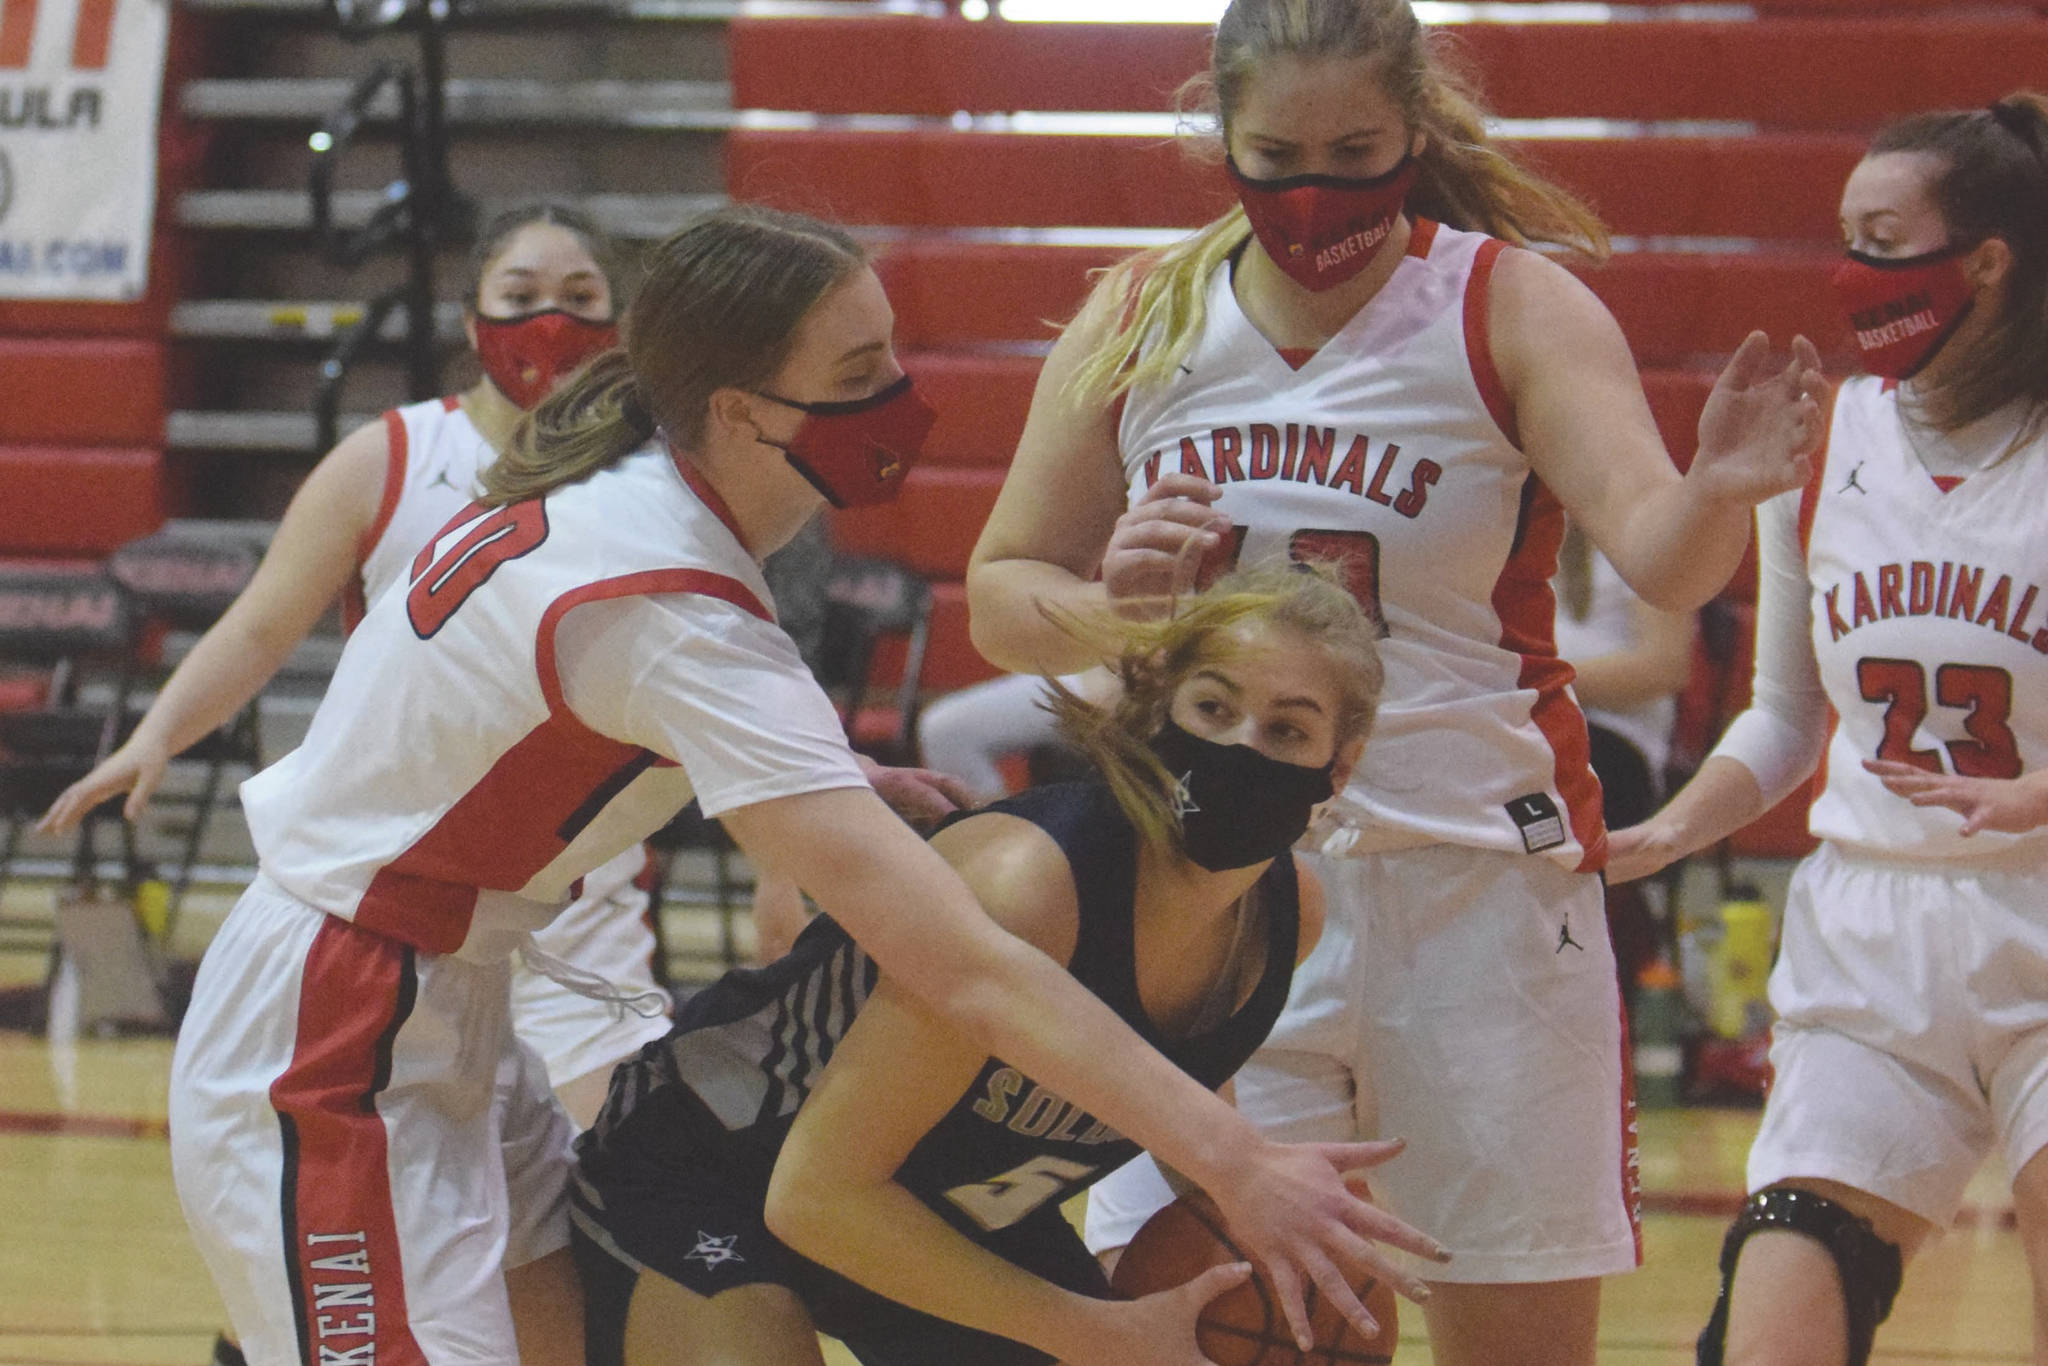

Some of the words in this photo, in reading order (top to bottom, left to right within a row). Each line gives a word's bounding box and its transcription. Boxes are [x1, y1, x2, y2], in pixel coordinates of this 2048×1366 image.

[1314, 216, 1391, 273] BASKETBALL
[1856, 308, 1940, 351] BASKETBALL
[1856, 656, 2024, 781] 23
[1524, 802, 1542, 816] L
